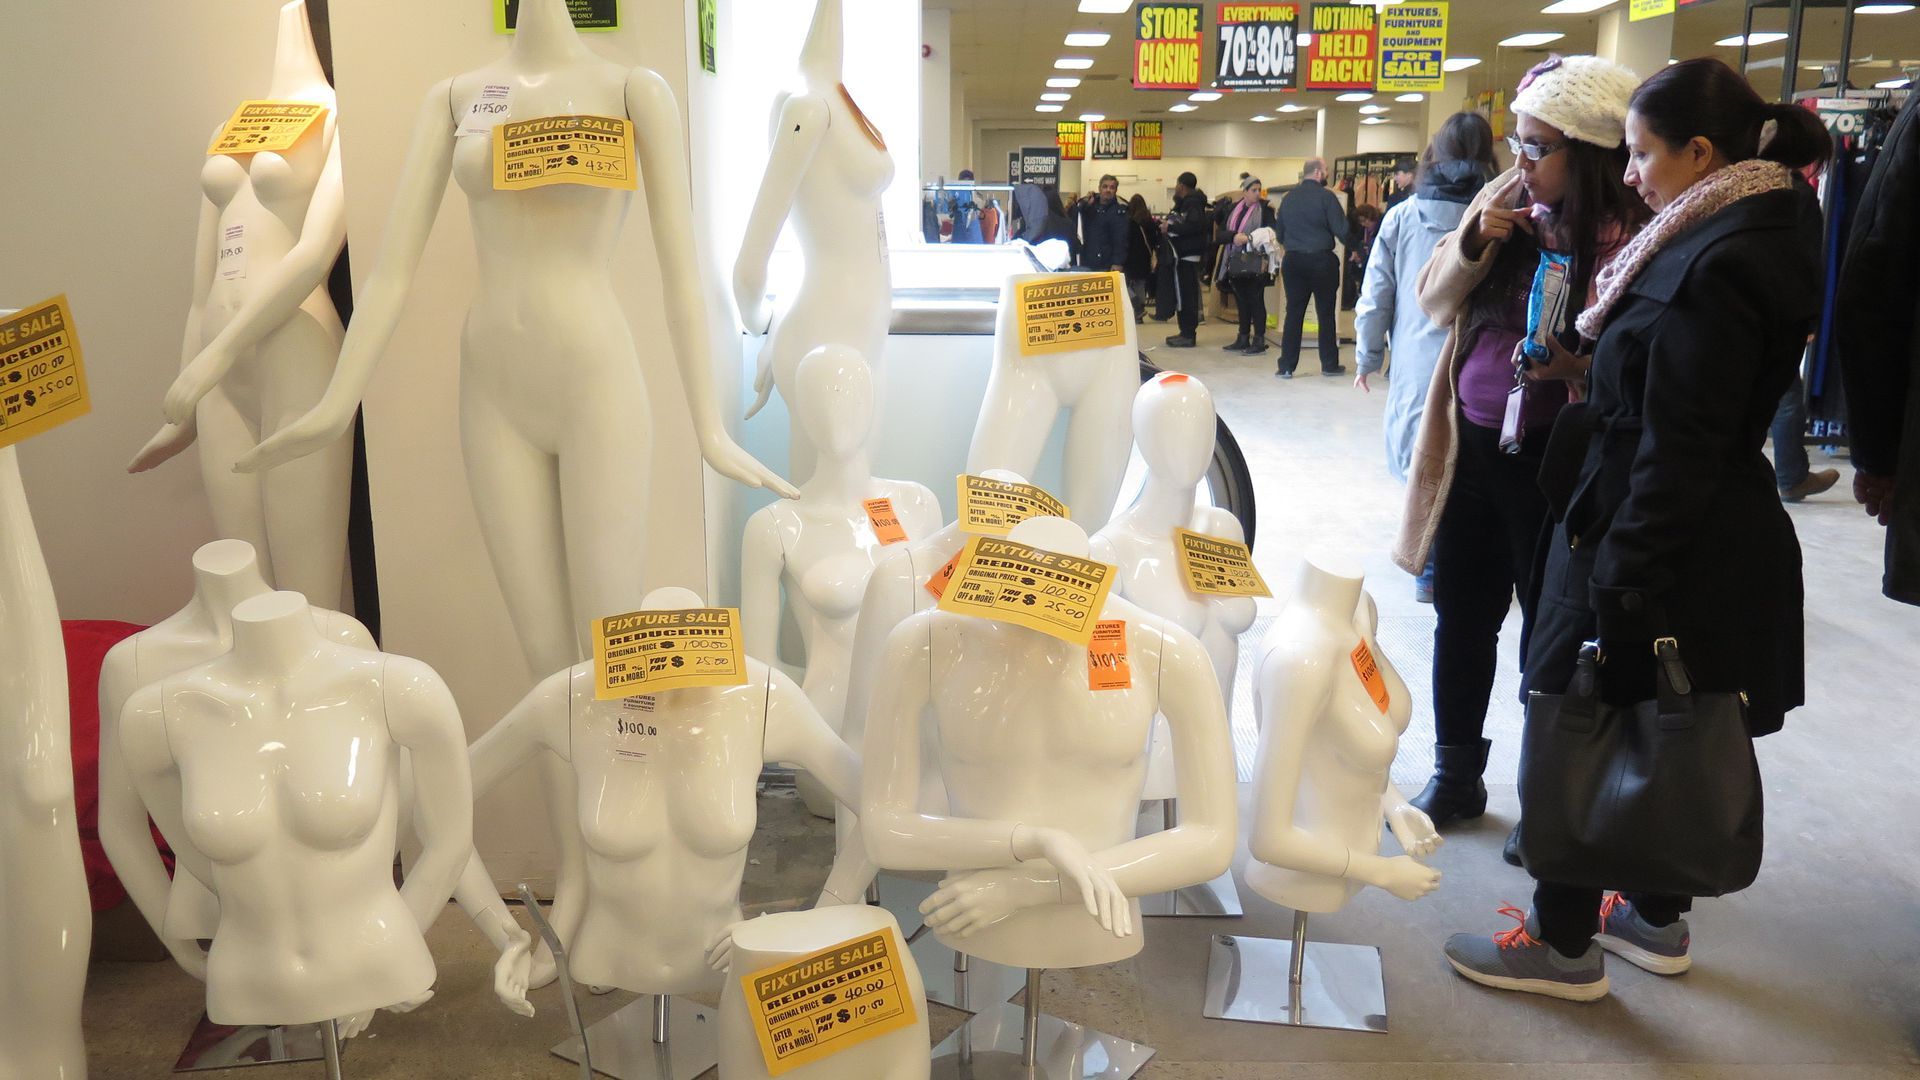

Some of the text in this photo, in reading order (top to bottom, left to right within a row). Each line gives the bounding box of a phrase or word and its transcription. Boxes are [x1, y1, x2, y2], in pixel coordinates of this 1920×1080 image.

[1223, 6, 1294, 22] EVERYTHING
[1313, 6, 1373, 31] NOTHING
[1387, 8, 1441, 17] FIXTURES,
[1140, 7, 1198, 40] STORE
[1384, 19, 1443, 28] FURNITURE
[1318, 34, 1368, 58] HELD
[1382, 37, 1443, 47] EQUIPMENT
[1138, 42, 1199, 84] CLOSING
[1392, 52, 1432, 61] FOR
[1310, 58, 1374, 82] BACK!
[1384, 60, 1440, 77] SALE
[506, 119, 622, 137] FIXTURE SALE
[1058, 122, 1085, 132] ENTIRE
[1134, 122, 1160, 137] STORE
[1058, 133, 1084, 143] STORE
[506, 148, 535, 158] ORIGINAL
[578, 144, 600, 154] 175
[1133, 138, 1160, 157] CLOSING
[506, 162, 524, 171] AFTER
[1024, 156, 1056, 164] CUSTOMER
[507, 172, 518, 180] OFF
[524, 168, 542, 177] MORE!
[1024, 164, 1054, 173] CHECKOUT
[1026, 280, 1113, 298] FIXTURE SALE
[1028, 295, 1110, 310] REDUCED!!!
[20, 309, 63, 338] SALE
[4, 393, 20, 406] YOU
[23, 390, 36, 407] $
[7, 404, 22, 416] PAY
[970, 478, 1064, 512] FIXTURE SALE
[970, 498, 996, 506] ORIGINAL
[1184, 538, 1245, 558] FIXTURE SALE
[980, 542, 1105, 578] FIXTURE SALE
[968, 569, 998, 580] ORIGINAL
[998, 572, 1018, 582] PRICE
[976, 558, 1092, 590] REDUCED!!!
[961, 582, 981, 592] AFTER
[1002, 588, 1022, 596] YOU
[957, 592, 968, 600] OFF
[974, 594, 994, 604] MORE!
[998, 594, 1020, 604] PAY
[1022, 593, 1037, 606] $
[606, 612, 729, 632] FIXTURE SALE
[609, 629, 724, 646] REDUCED!!!
[607, 648, 637, 659] ORIGINAL
[638, 644, 657, 652] PRICE
[649, 656, 668, 664] YOU
[670, 655, 684, 668] $
[608, 664, 626, 674] AFTER
[649, 664, 668, 672] PAY
[608, 676, 619, 684] OFF
[626, 670, 646, 681] MORE!
[624, 698, 656, 706] FURNITURE
[618, 718, 657, 736] $100.00
[760, 940, 884, 996] FIXTURE SALE
[766, 961, 883, 1010] REDUCED!!!
[768, 1006, 800, 1026] ORIGINAL
[800, 1000, 820, 1014] PRICE
[844, 978, 884, 1000] 40.00
[814, 1012, 832, 1025] YOU
[836, 1008, 851, 1024] $
[817, 1022, 834, 1034] PAY
[772, 1028, 792, 1043] AFTER
[777, 1032, 815, 1055] OFF & MORE!
